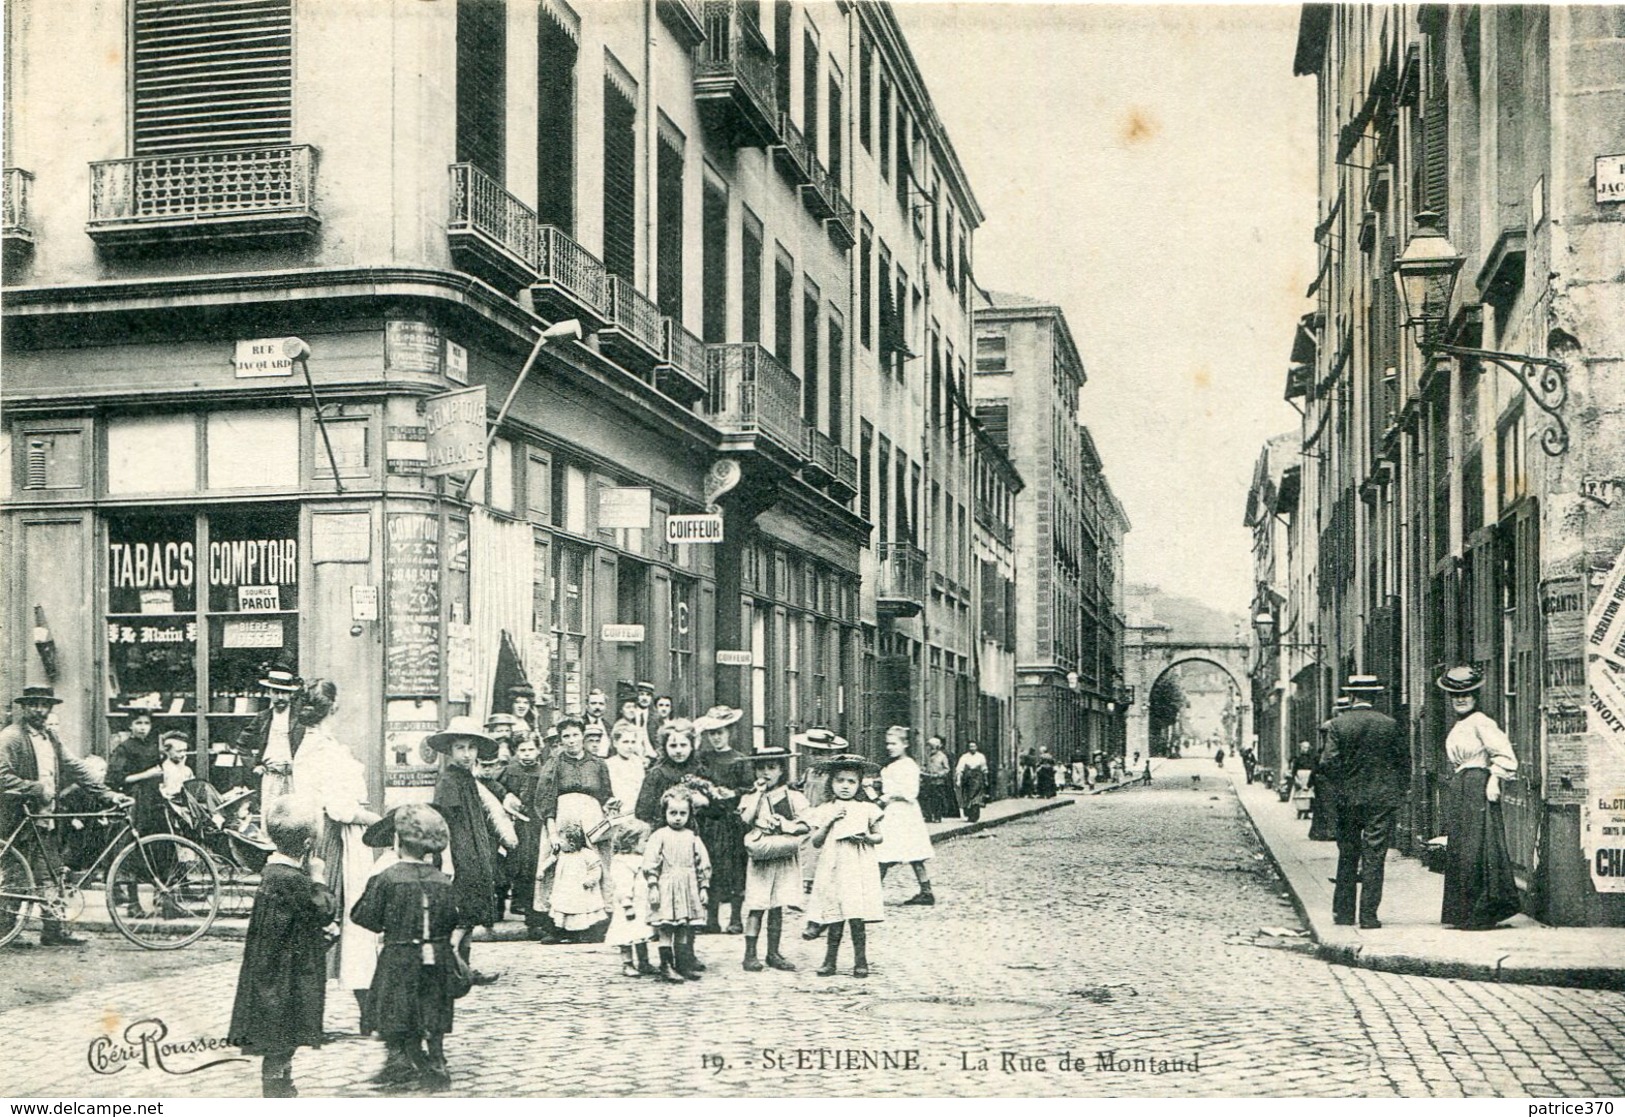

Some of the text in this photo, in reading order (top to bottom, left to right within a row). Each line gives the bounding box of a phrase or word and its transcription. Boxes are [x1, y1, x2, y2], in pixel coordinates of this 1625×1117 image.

[1598, 182, 1625, 193] JAC
[252, 344, 275, 354] RUE
[239, 359, 291, 372] JACQUARD
[427, 400, 484, 435] COMPTOIR
[428, 441, 485, 467] TABACS
[669, 520, 720, 538] COIFFEUR
[110, 539, 297, 587] TABACS COMPTOIR
[245, 588, 272, 596] SOURCE
[241, 597, 277, 610] PAROT
[120, 626, 183, 643] Le Matin
[603, 627, 642, 638] COIFFEUR
[718, 652, 750, 662] COIFFEUR
[1589, 685, 1625, 734] ENOIT
